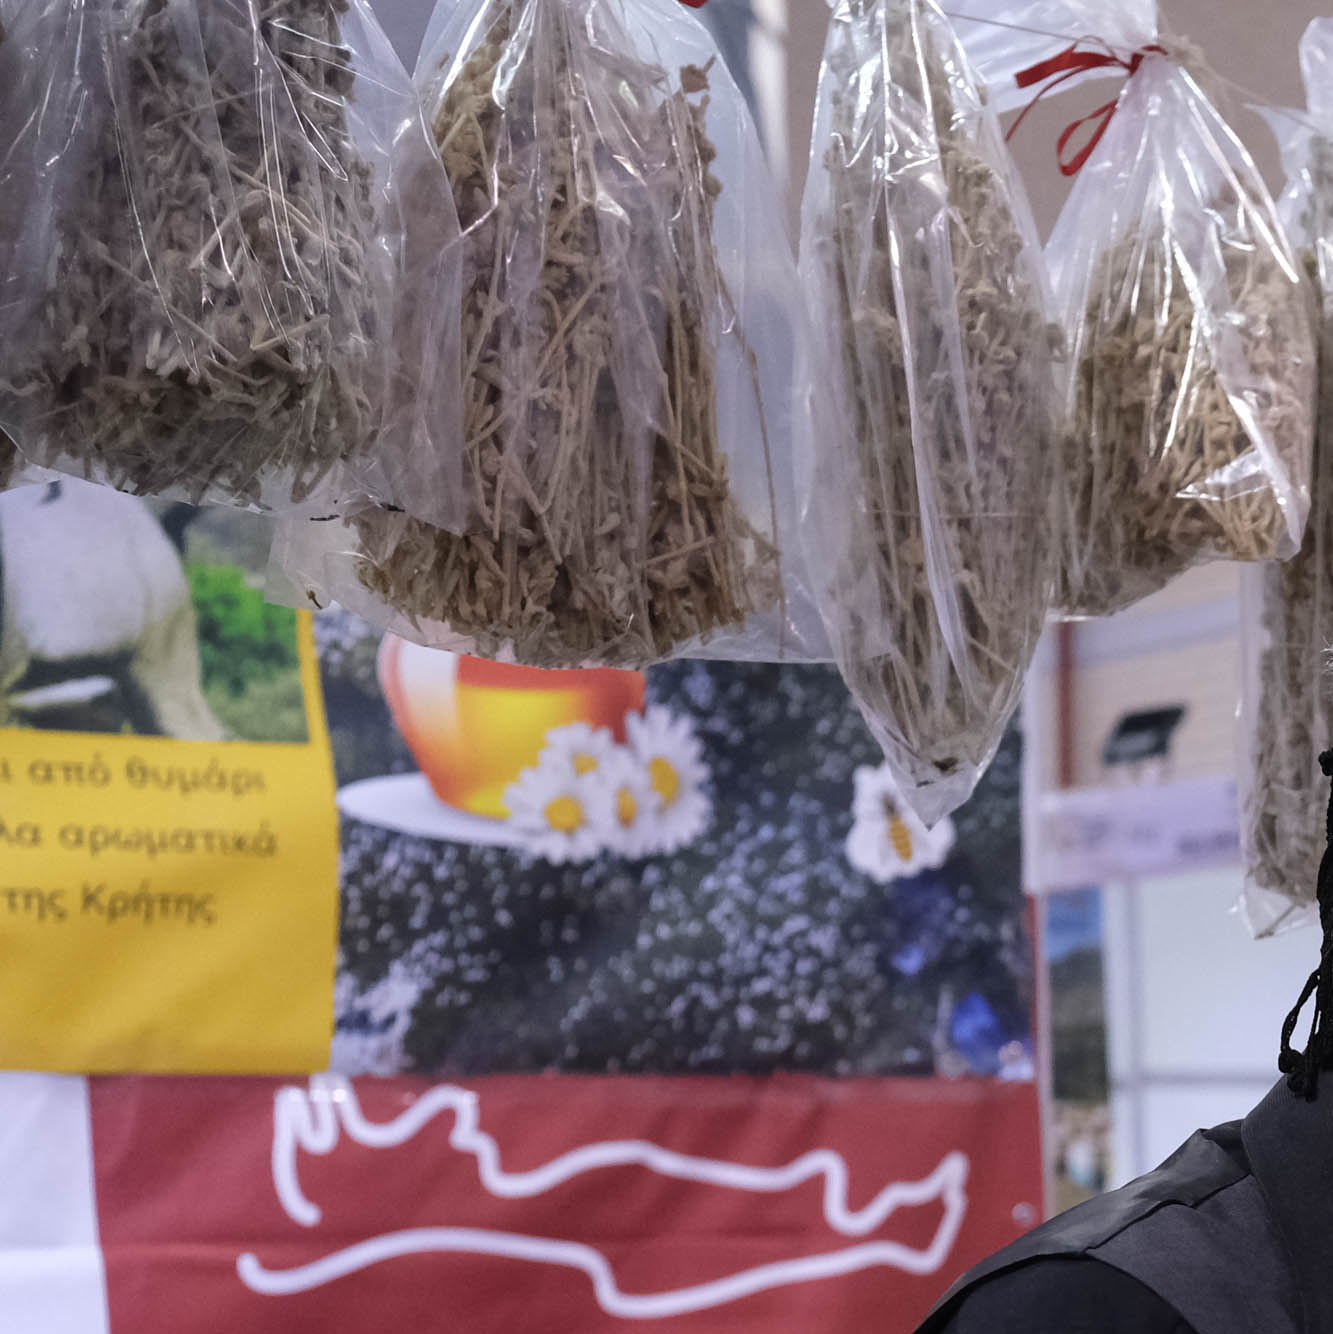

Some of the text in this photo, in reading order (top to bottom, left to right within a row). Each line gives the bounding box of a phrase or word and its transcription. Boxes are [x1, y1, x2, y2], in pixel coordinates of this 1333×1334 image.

[28, 751, 112, 788] από
[125, 755, 267, 796] θυμάρι
[58, 819, 278, 858] αρωματικά
[4, 880, 218, 926] της Κρήτης
